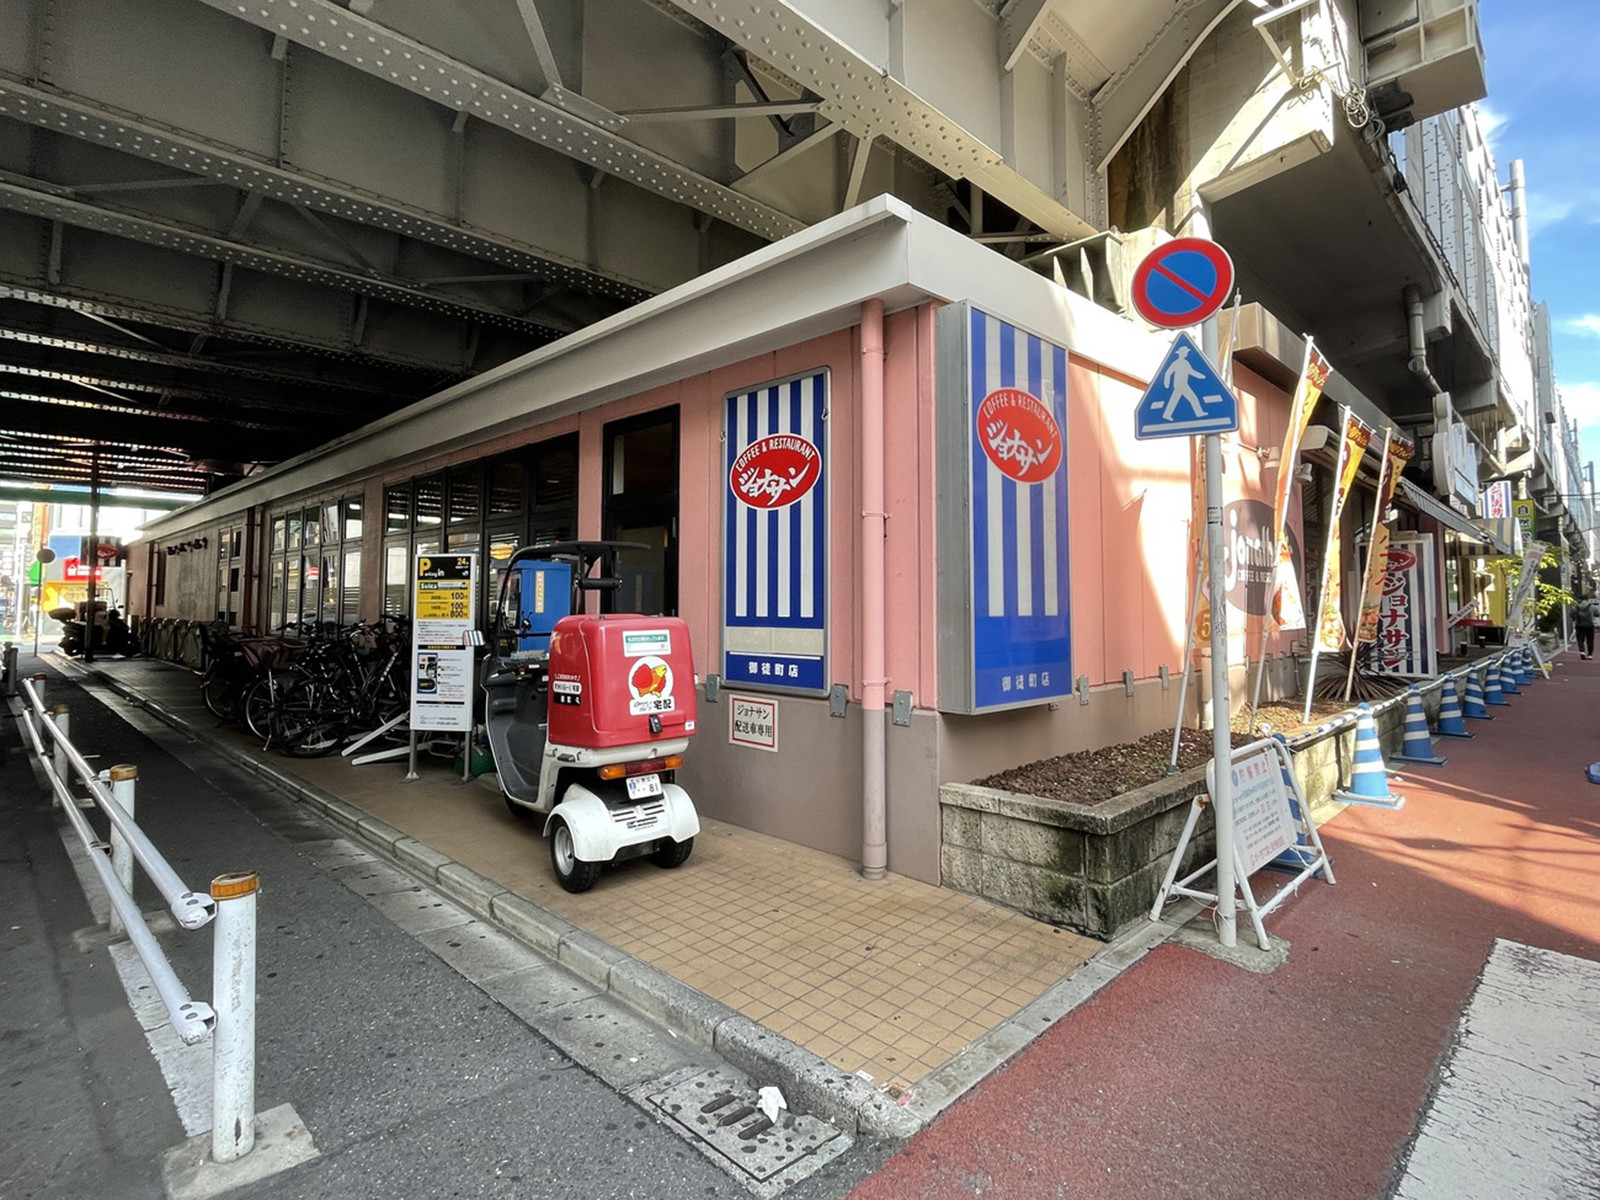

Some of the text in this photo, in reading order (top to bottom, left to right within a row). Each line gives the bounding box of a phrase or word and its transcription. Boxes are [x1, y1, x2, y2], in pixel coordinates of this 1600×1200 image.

[983, 393, 1058, 438] COFFEE & RESTAURANT
[735, 438, 815, 472] COFFEE & RESTAURANT
[986, 419, 1054, 476] ジョナサン
[738, 463, 810, 506] ジョナサン
[1380, 577, 1409, 668] ジョナサン
[748, 661, 799, 678] 御徒町店
[1002, 671, 1050, 692] 御徒町店
[737, 704, 770, 720] ジョナサン
